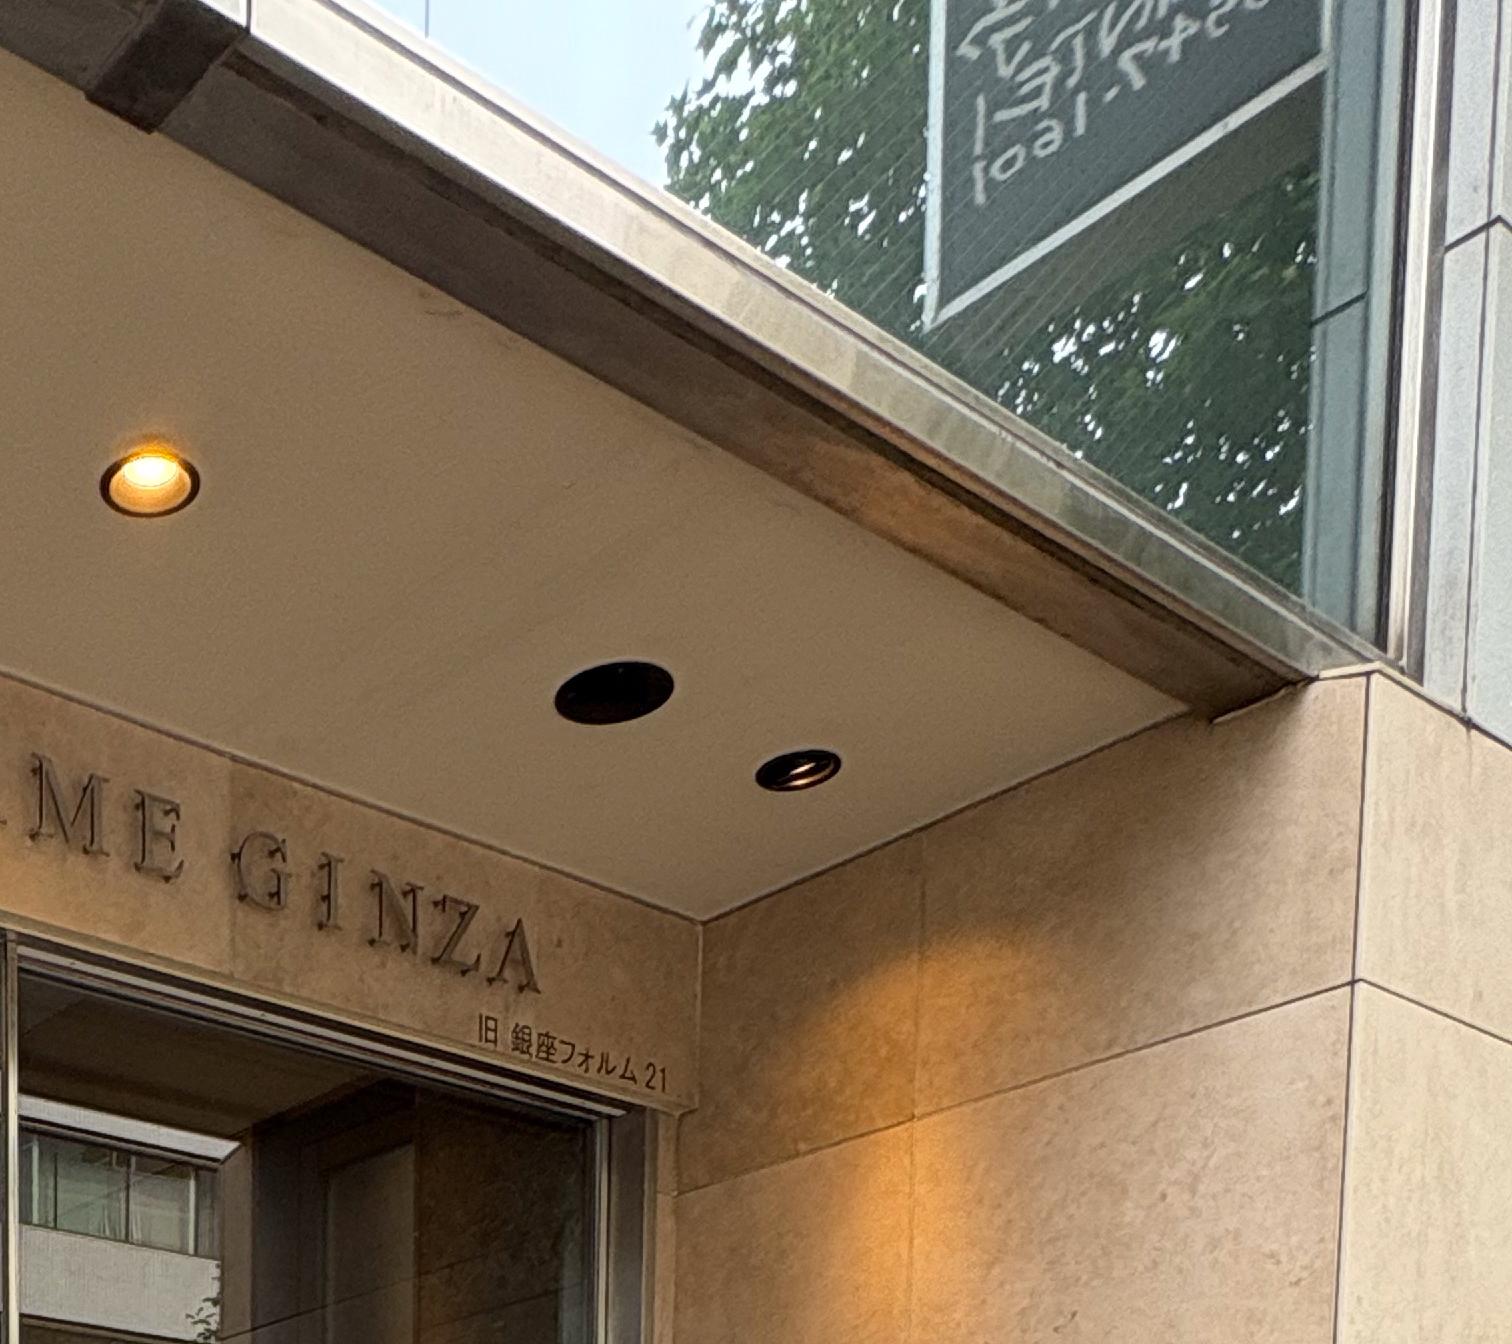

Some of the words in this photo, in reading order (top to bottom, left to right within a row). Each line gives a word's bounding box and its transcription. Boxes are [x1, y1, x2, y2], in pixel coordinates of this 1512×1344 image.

[231, 828, 543, 996] GINZA
[479, 1013, 498, 1048] 旧
[511, 1022, 638, 1085] 銀座フォルム
[645, 1062, 666, 1093] 21
